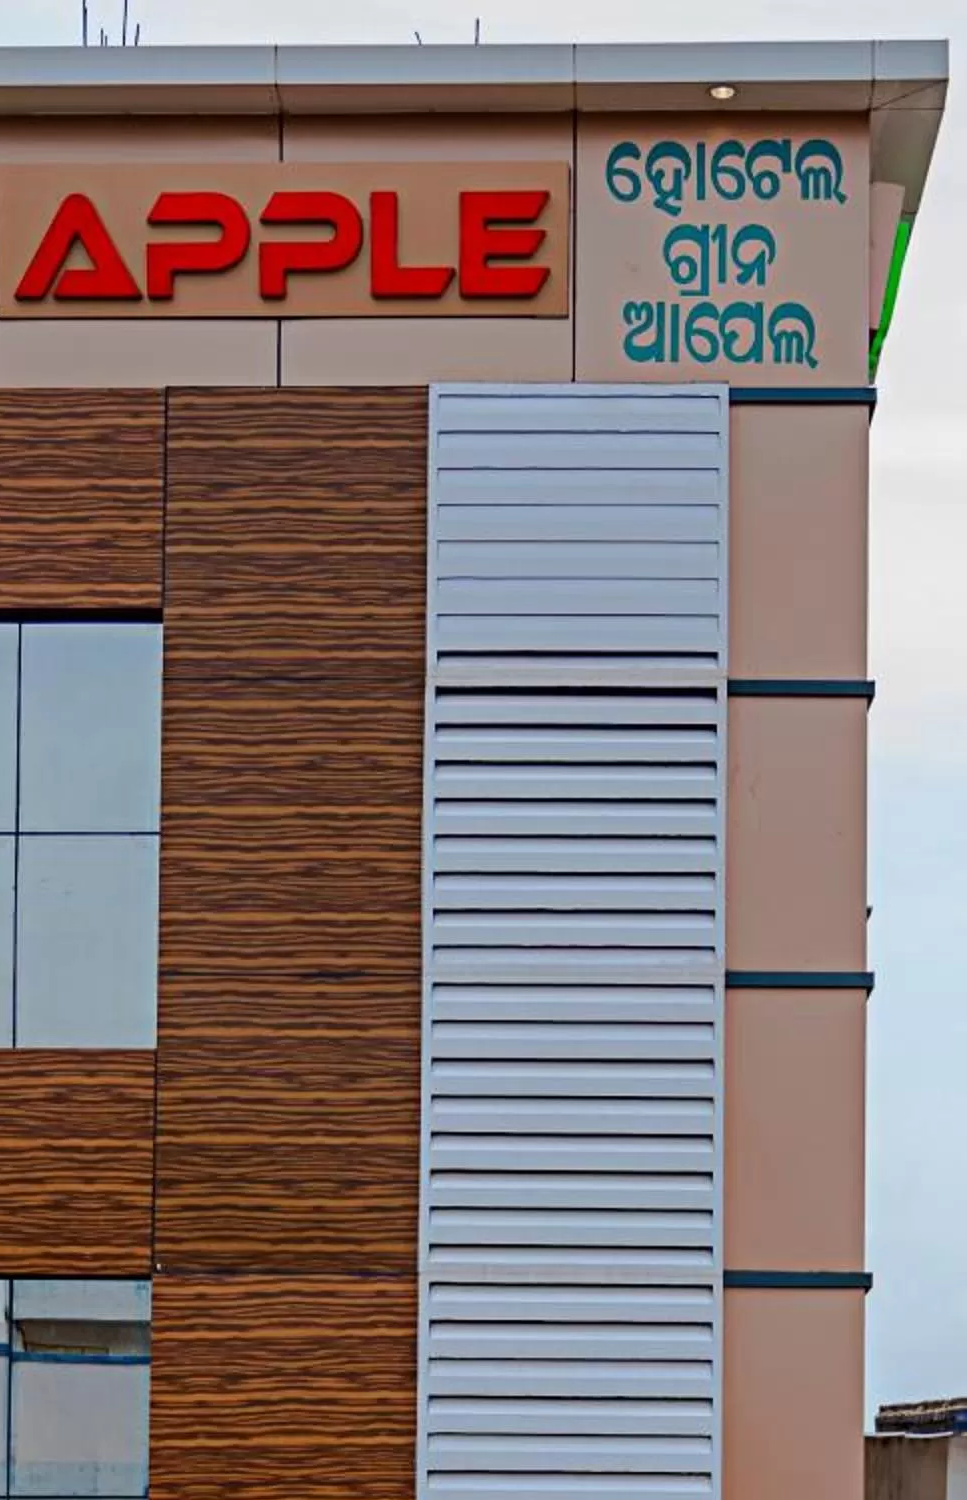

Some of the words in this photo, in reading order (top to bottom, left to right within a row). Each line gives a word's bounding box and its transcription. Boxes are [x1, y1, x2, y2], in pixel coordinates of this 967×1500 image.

[606, 139, 847, 216] ହୋଟେଲ
[14, 191, 551, 300] APPLE
[663, 223, 776, 297] ଗ୍ରୀନ
[623, 302, 818, 369] ଆପେଲ
